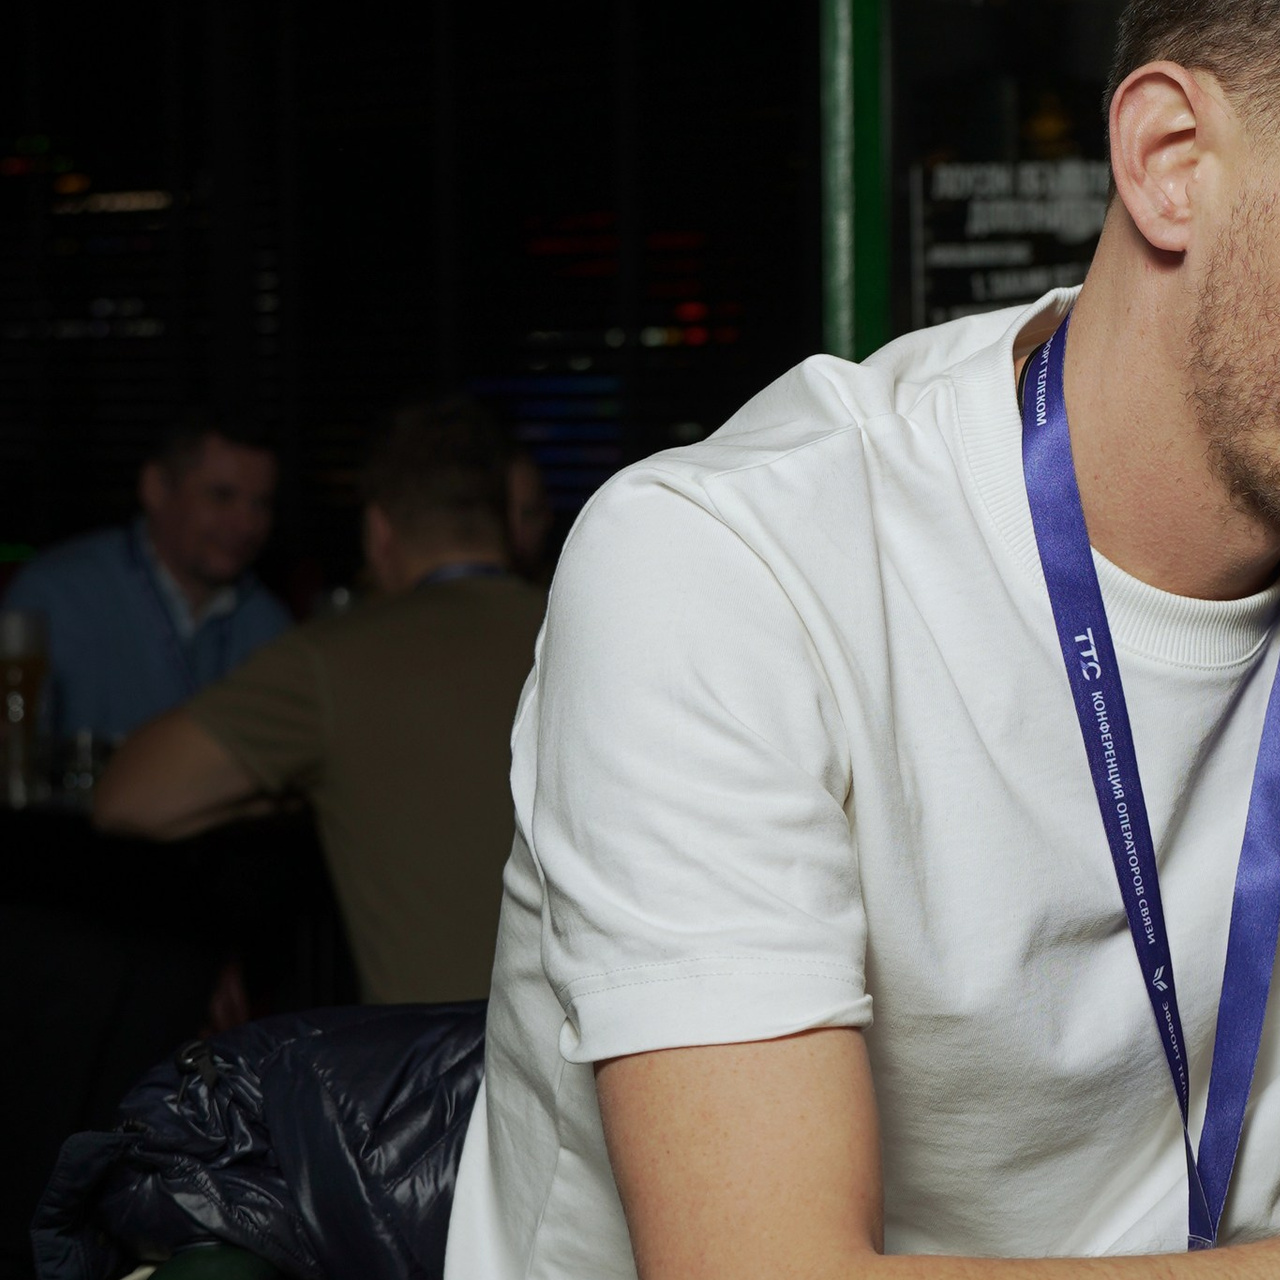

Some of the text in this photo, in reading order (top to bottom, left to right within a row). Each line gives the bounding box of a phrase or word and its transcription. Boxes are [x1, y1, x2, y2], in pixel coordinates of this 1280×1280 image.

[1036, 366, 1048, 426] ТЕЛЕКОМ
[1074, 627, 1101, 681] ТТС
[1092, 691, 1155, 944] КОНФЕРЕНЦИЯ ОПЕРАТОРОВ СВЯЗИ
[1162, 1000, 1181, 1060] ЭФФОРТ
